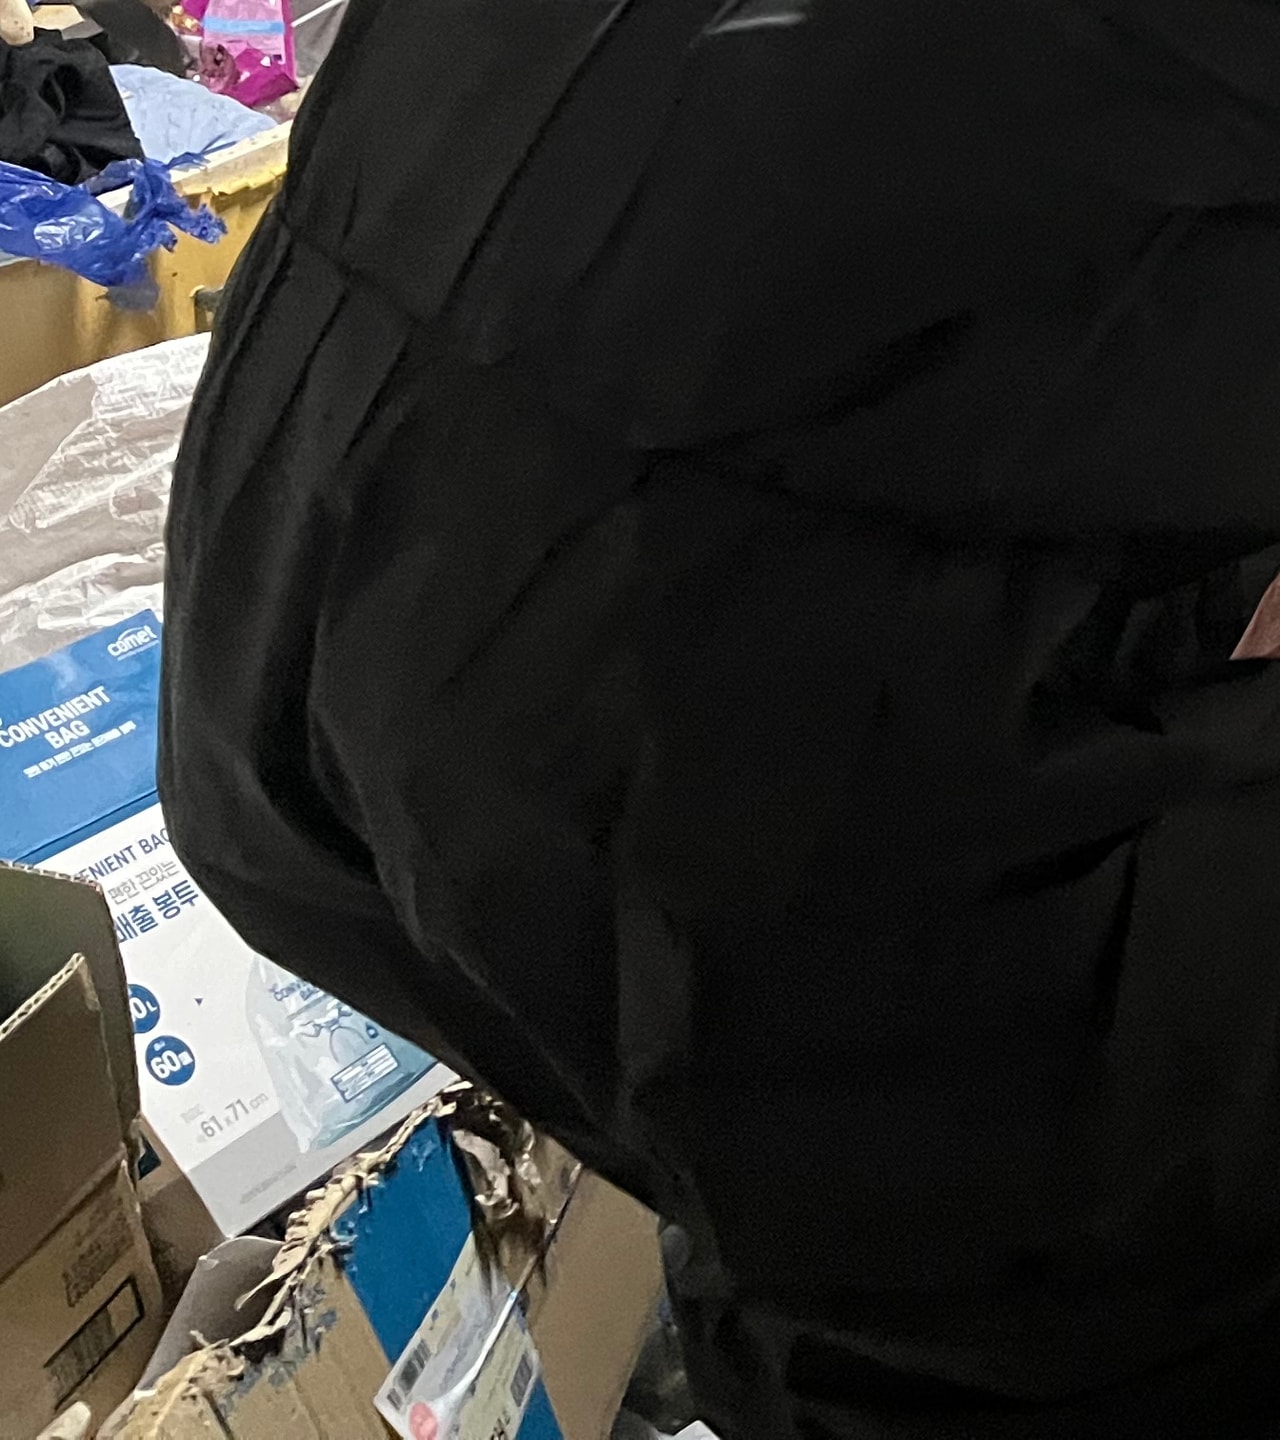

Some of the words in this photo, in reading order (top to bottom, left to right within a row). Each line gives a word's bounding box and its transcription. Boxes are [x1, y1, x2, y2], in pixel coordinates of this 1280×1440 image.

[107, 625, 158, 657] comet
[0, 685, 111, 748] CONVENIENT
[44, 720, 91, 750] BAG
[107, 878, 140, 906] 편한
[151, 879, 199, 920] 봉투
